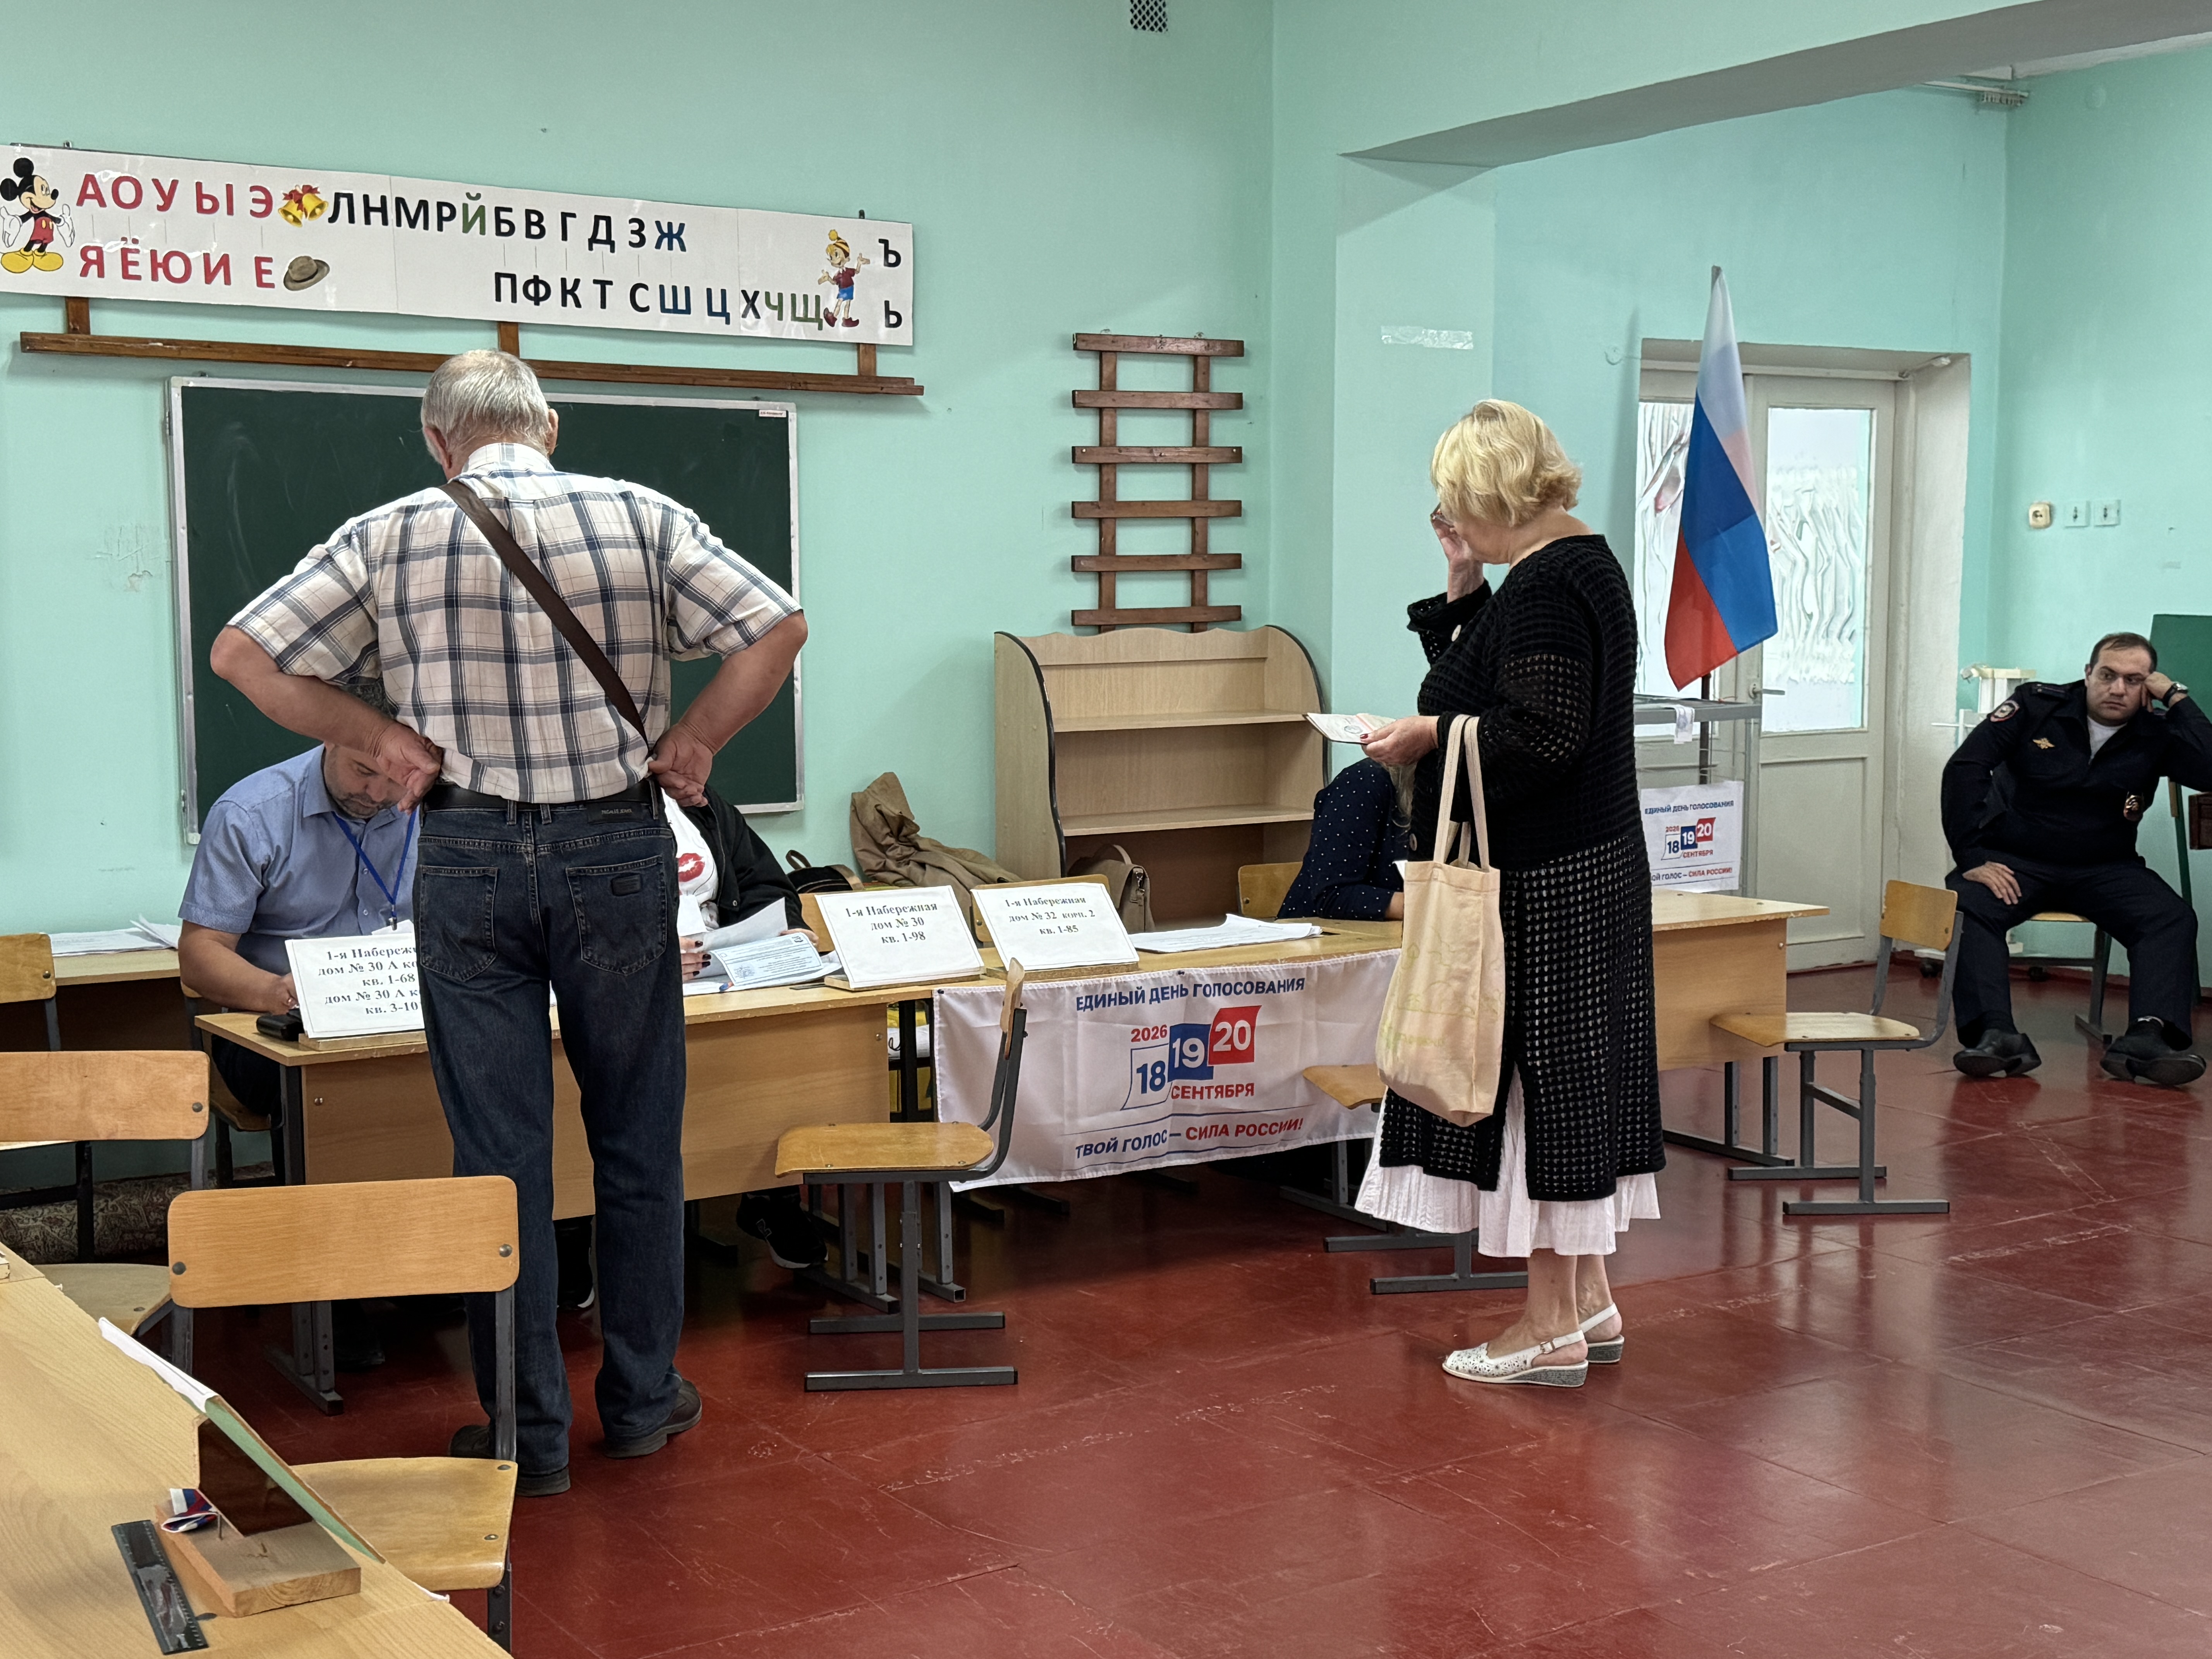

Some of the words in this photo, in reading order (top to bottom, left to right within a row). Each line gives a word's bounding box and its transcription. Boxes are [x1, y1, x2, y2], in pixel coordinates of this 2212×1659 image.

[76, 174, 106, 208] А
[112, 176, 143, 209] О
[151, 178, 179, 212] У
[195, 181, 234, 216] Ы
[249, 185, 273, 218] Э
[328, 192, 355, 224] Л
[362, 194, 388, 226] Н
[395, 196, 429, 231] М
[436, 201, 457, 232] Р
[462, 192, 486, 235] Й
[494, 206, 515, 237] Б
[525, 209, 546, 239] В
[560, 211, 577, 242] Г
[588, 215, 615, 253] Д
[629, 218, 646, 248] З
[654, 220, 686, 252] Ж
[878, 239, 901, 268] Ъ
[80, 245, 105, 278] Я
[120, 237, 142, 280] Ё
[150, 249, 192, 283] Ю
[203, 252, 231, 285] И
[254, 256, 275, 288] Е
[495, 272, 517, 304] П
[522, 275, 551, 306] Ф
[560, 277, 582, 308] К
[592, 279, 613, 309] Т
[629, 283, 650, 313] С
[659, 284, 691, 315] Ш
[706, 288, 730, 325] Ц
[741, 289, 761, 319] Х
[764, 291, 783, 321] Ч
[790, 293, 823, 331] Щ
[884, 300, 902, 328] Ь
[1673, 805, 1689, 813] ДЕНЬ
[1667, 840, 1679, 854] 18
[1682, 831, 1695, 845] 19
[1697, 823, 1712, 837] 20
[1683, 850, 1713, 858] СЕНТЯБРЯ
[1651, 873, 1661, 881] ОЙ
[845, 908, 864, 917] 1-я
[866, 903, 938, 915] Набережная
[1023, 898, 1087, 907] Набережная
[871, 922, 893, 931] дом
[895, 918, 909, 928] №
[911, 917, 924, 926] 30
[902, 931, 926, 941] 1-98
[327, 951, 347, 960] 1-я
[318, 967, 344, 976] дом
[349, 963, 364, 973] №
[368, 961, 383, 971] 30
[388, 960, 398, 969] А
[388, 973, 416, 984] 1-68
[325, 995, 351, 1005] дом
[356, 991, 371, 1001] №
[375, 989, 390, 999] 30
[395, 989, 405, 998] А
[1076, 986, 1146, 1012] ЕДИНЫЙ
[1149, 984, 1188, 1005] ДЕНЬ
[1193, 978, 1305, 998] ГОЛОСОВАНИЯ
[366, 1006, 386, 1015] кв.
[390, 1001, 421, 1012] 3-10
[1131, 1024, 1168, 1042] 2026
[1136, 1060, 1166, 1094] 18
[1172, 1038, 1205, 1068] 19
[1212, 1020, 1252, 1052] 20
[1171, 1083, 1254, 1100] СЕНТЯБРЯ
[1075, 1137, 1118, 1159] ТВОЙ
[1123, 1129, 1168, 1152] ГОЛОС
[1186, 1125, 1229, 1140] СИЛА
[1235, 1118, 1304, 1137] РОССИИ!
